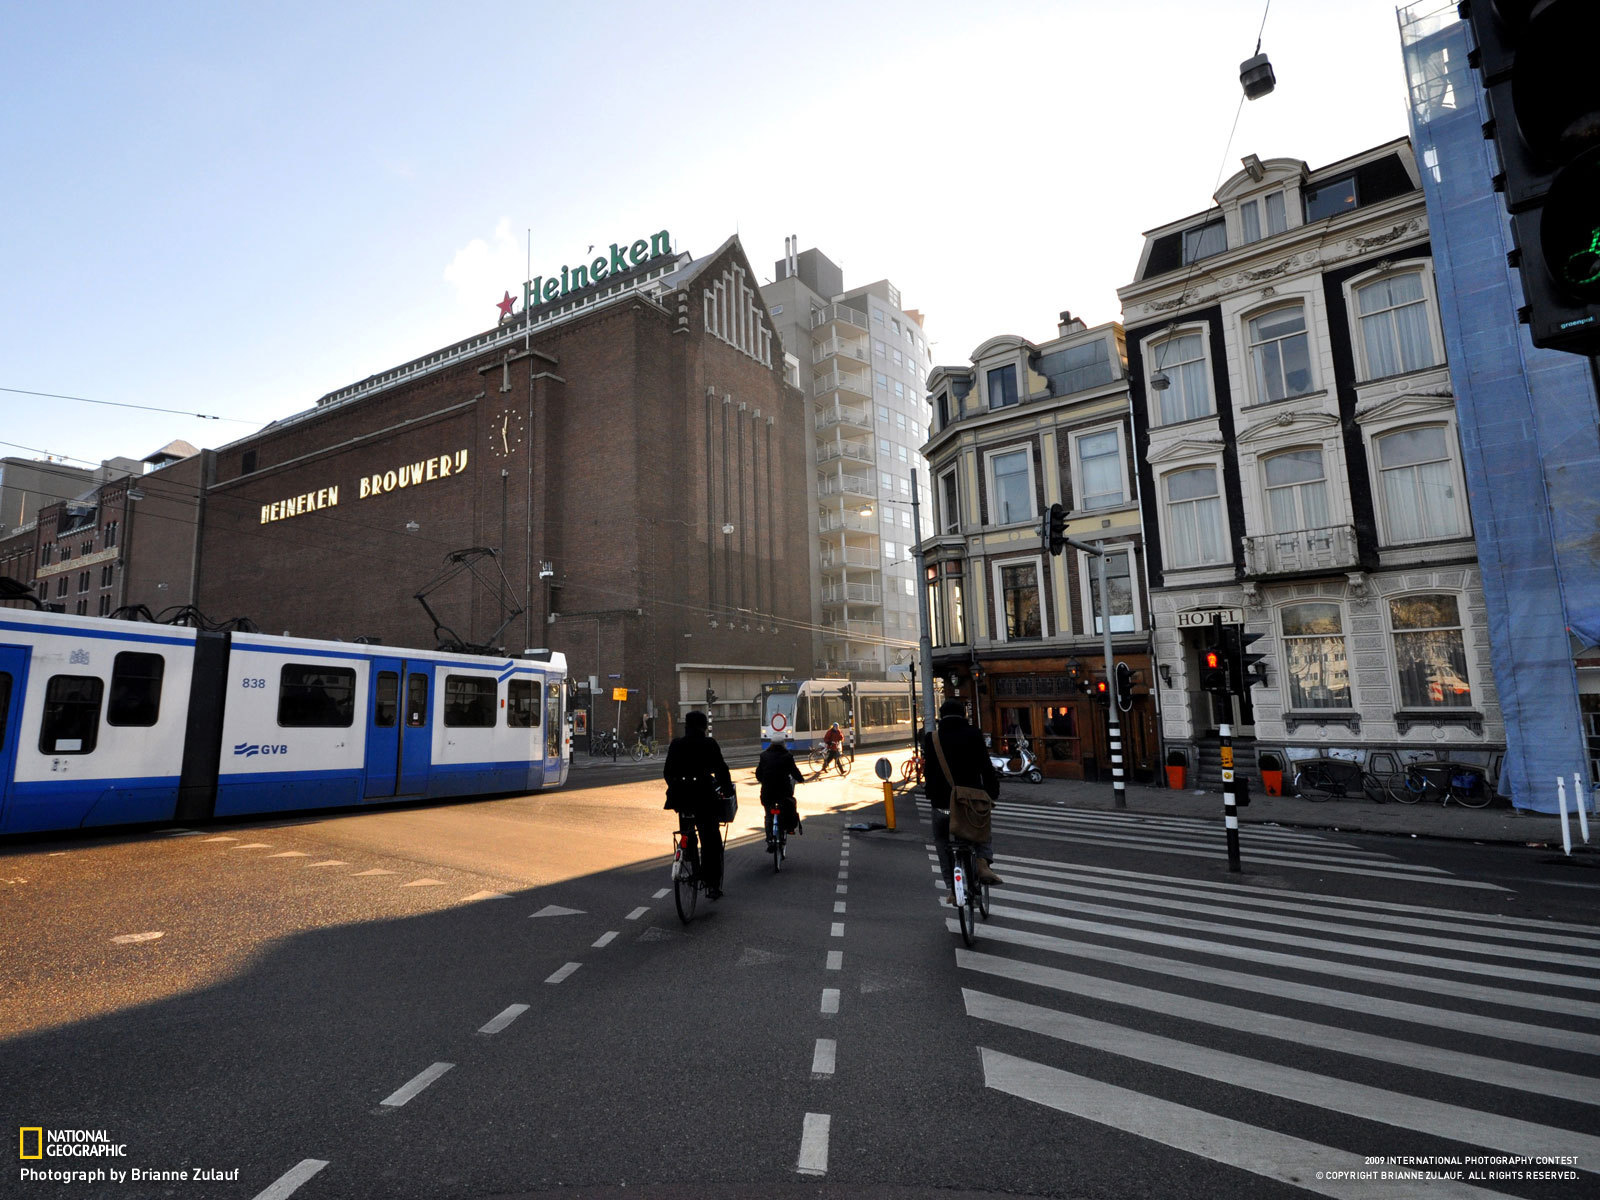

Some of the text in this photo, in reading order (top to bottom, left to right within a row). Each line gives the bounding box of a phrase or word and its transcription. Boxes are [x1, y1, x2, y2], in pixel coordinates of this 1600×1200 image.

[522, 229, 671, 311] Heineken
[260, 449, 468, 524] HEINEKEN BROUWERIJ
[1178, 610, 1239, 626] HOTEL
[242, 678, 266, 689] 838
[261, 744, 288, 755] GVB
